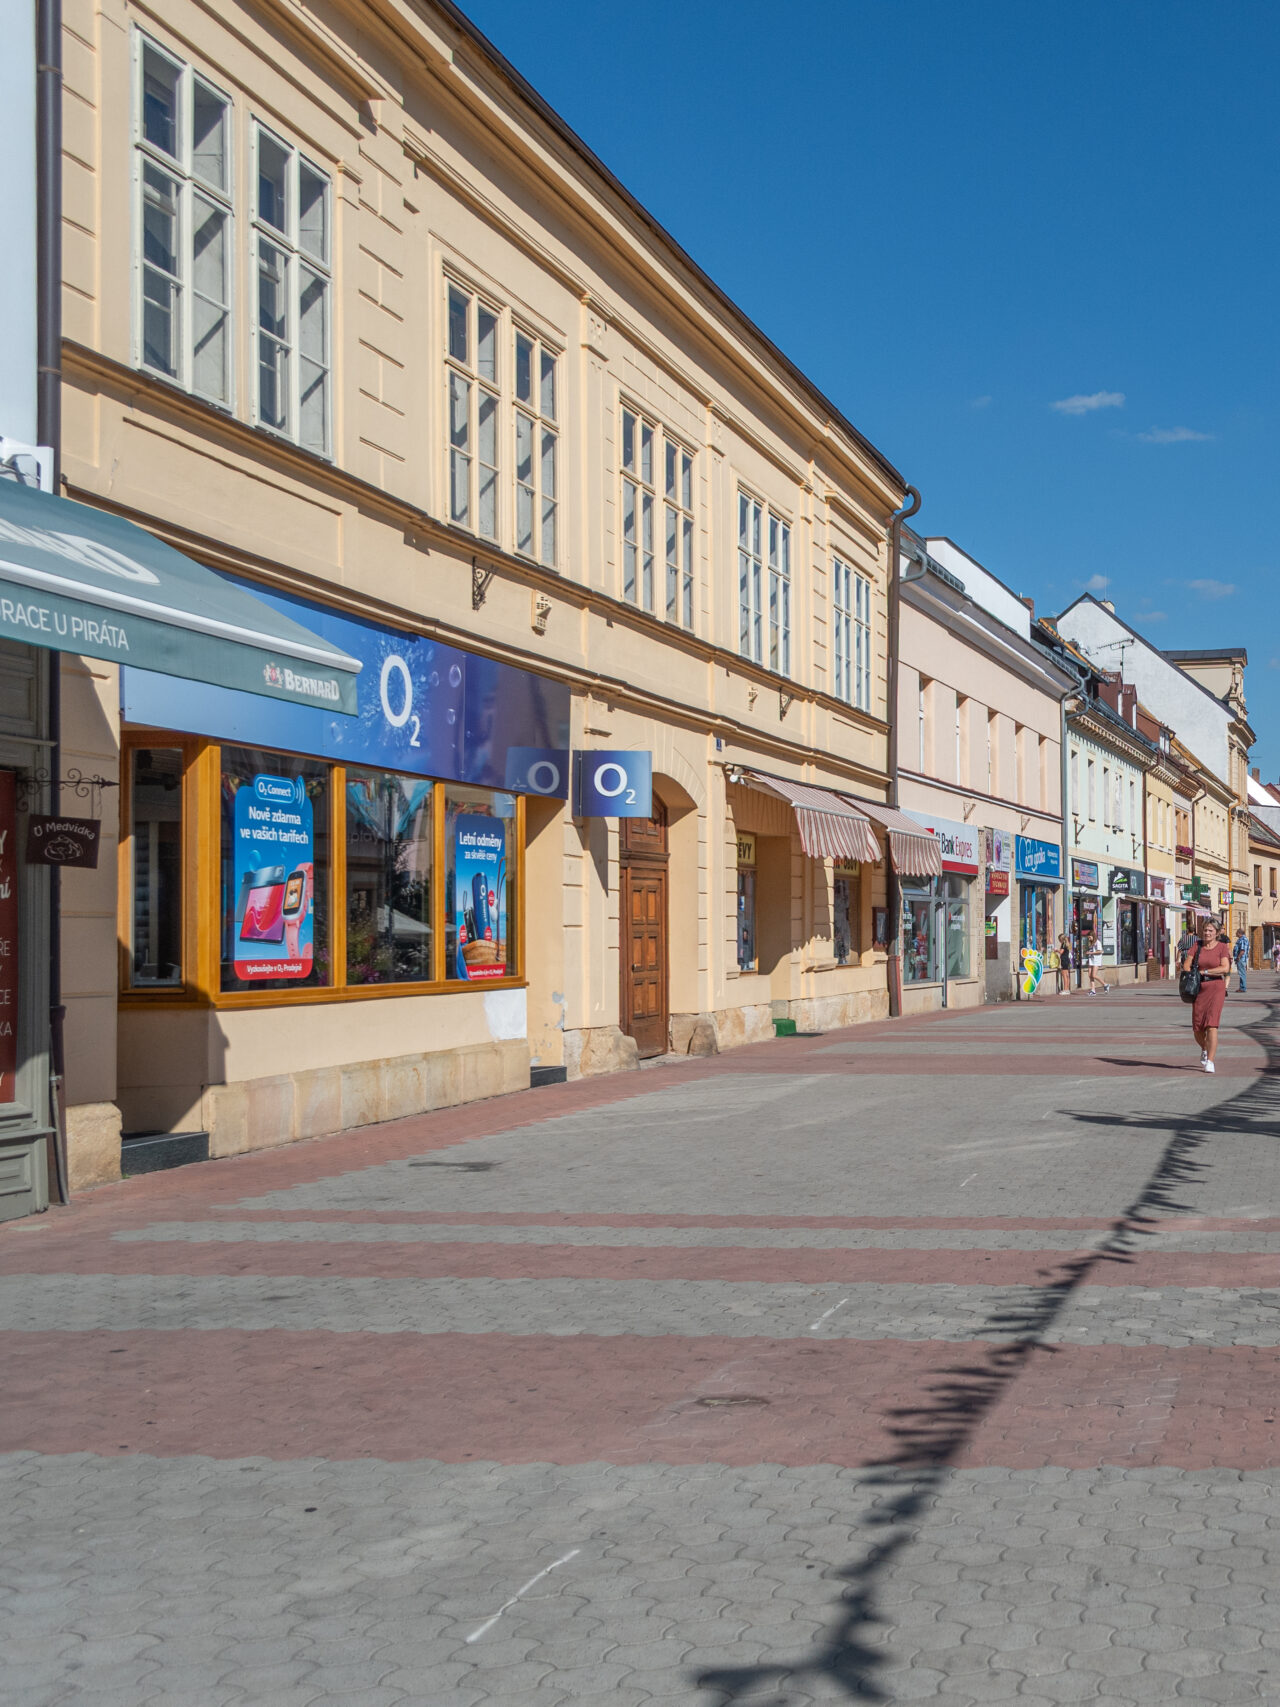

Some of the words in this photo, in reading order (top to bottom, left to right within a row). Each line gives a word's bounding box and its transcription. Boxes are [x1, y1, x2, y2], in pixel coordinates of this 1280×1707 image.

[54, 612, 67, 635] U
[71, 616, 130, 651] PIRÁTA
[284, 668, 340, 700] BERNARD
[267, 784, 291, 798] Connect
[594, 763, 637, 804] O2
[249, 806, 271, 822] Nově
[272, 809, 302, 825] zdarma
[33, 825, 43, 837] U
[240, 828, 251, 839] ve
[252, 825, 278, 841] vašich
[279, 829, 309, 845] tarifech
[459, 831, 477, 846] Letní
[477, 833, 502, 852] odměny
[941, 833, 955, 856] Bank
